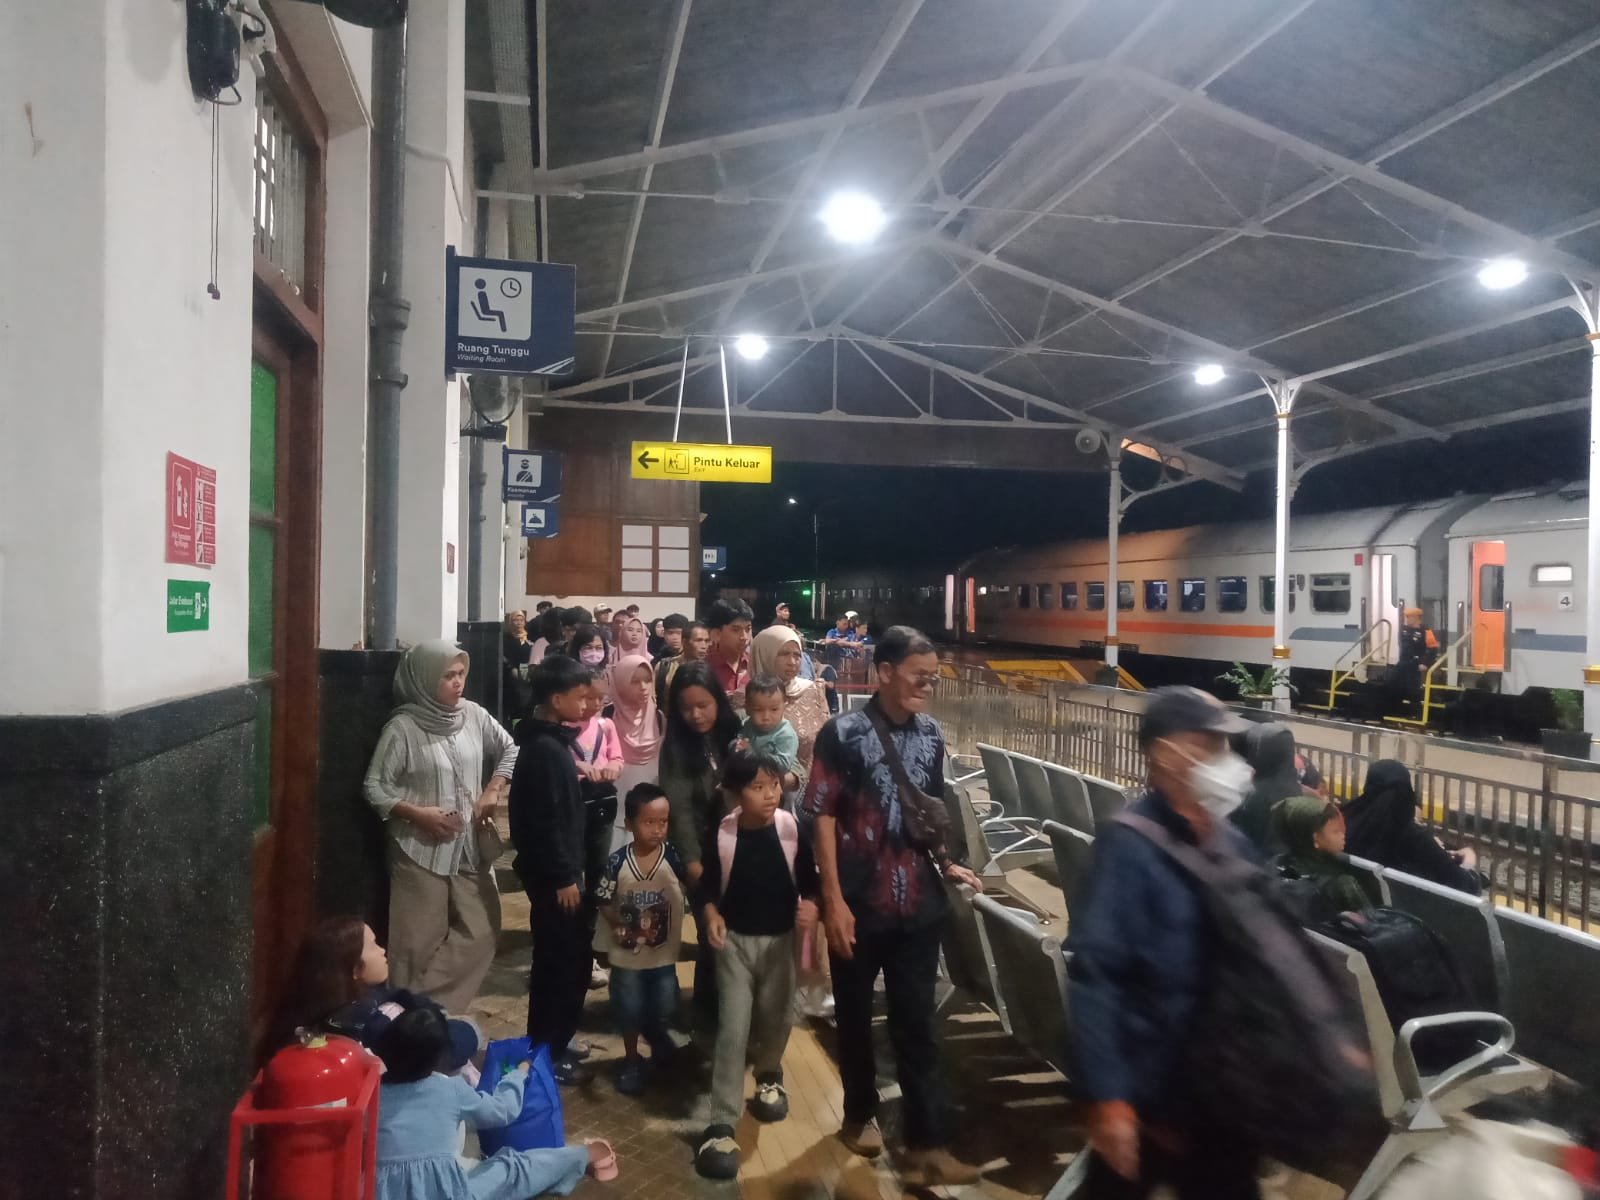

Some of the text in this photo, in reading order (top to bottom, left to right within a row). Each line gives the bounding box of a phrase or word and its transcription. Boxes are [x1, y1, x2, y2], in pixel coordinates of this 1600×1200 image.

[457, 342, 530, 357] Ruang Tunggu
[457, 354, 484, 362] Waiting
[693, 456, 760, 469] Pintu Keluar
[1560, 596, 1571, 607] 4
